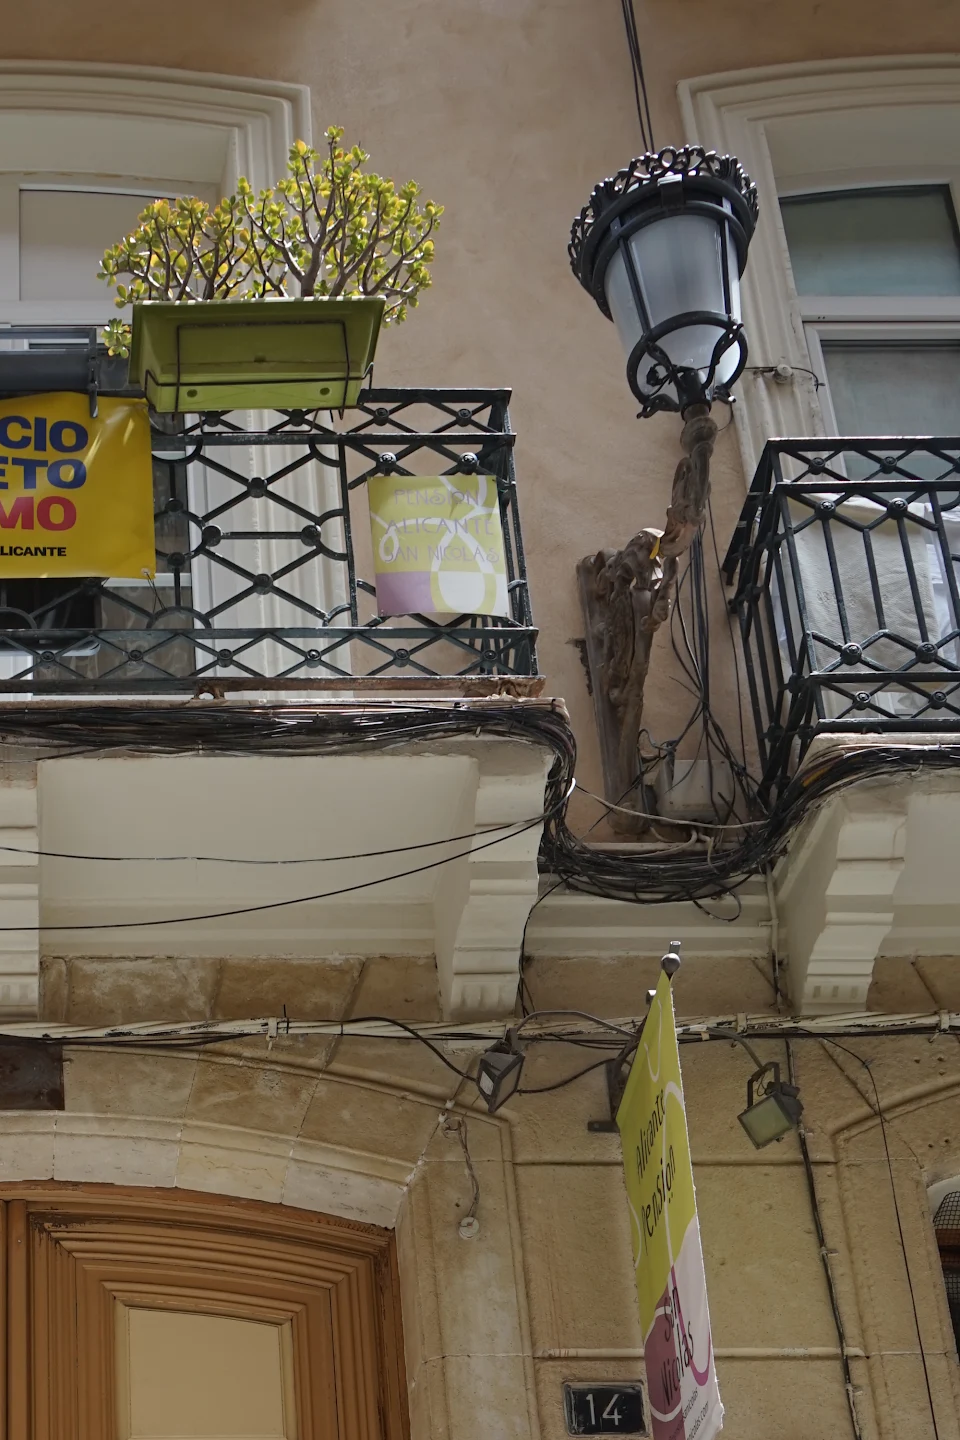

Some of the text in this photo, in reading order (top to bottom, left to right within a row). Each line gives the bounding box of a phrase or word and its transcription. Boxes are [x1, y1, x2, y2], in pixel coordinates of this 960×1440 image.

[393, 488, 480, 506] PENSION
[385, 518, 495, 536] ALICANTE
[383, 545, 500, 564] SAN NICOLAS
[636, 1089, 667, 1184] Alicante
[664, 1286, 682, 1343] San
[661, 1320, 695, 1407] Nicolas
[585, 1393, 622, 1426] 14
